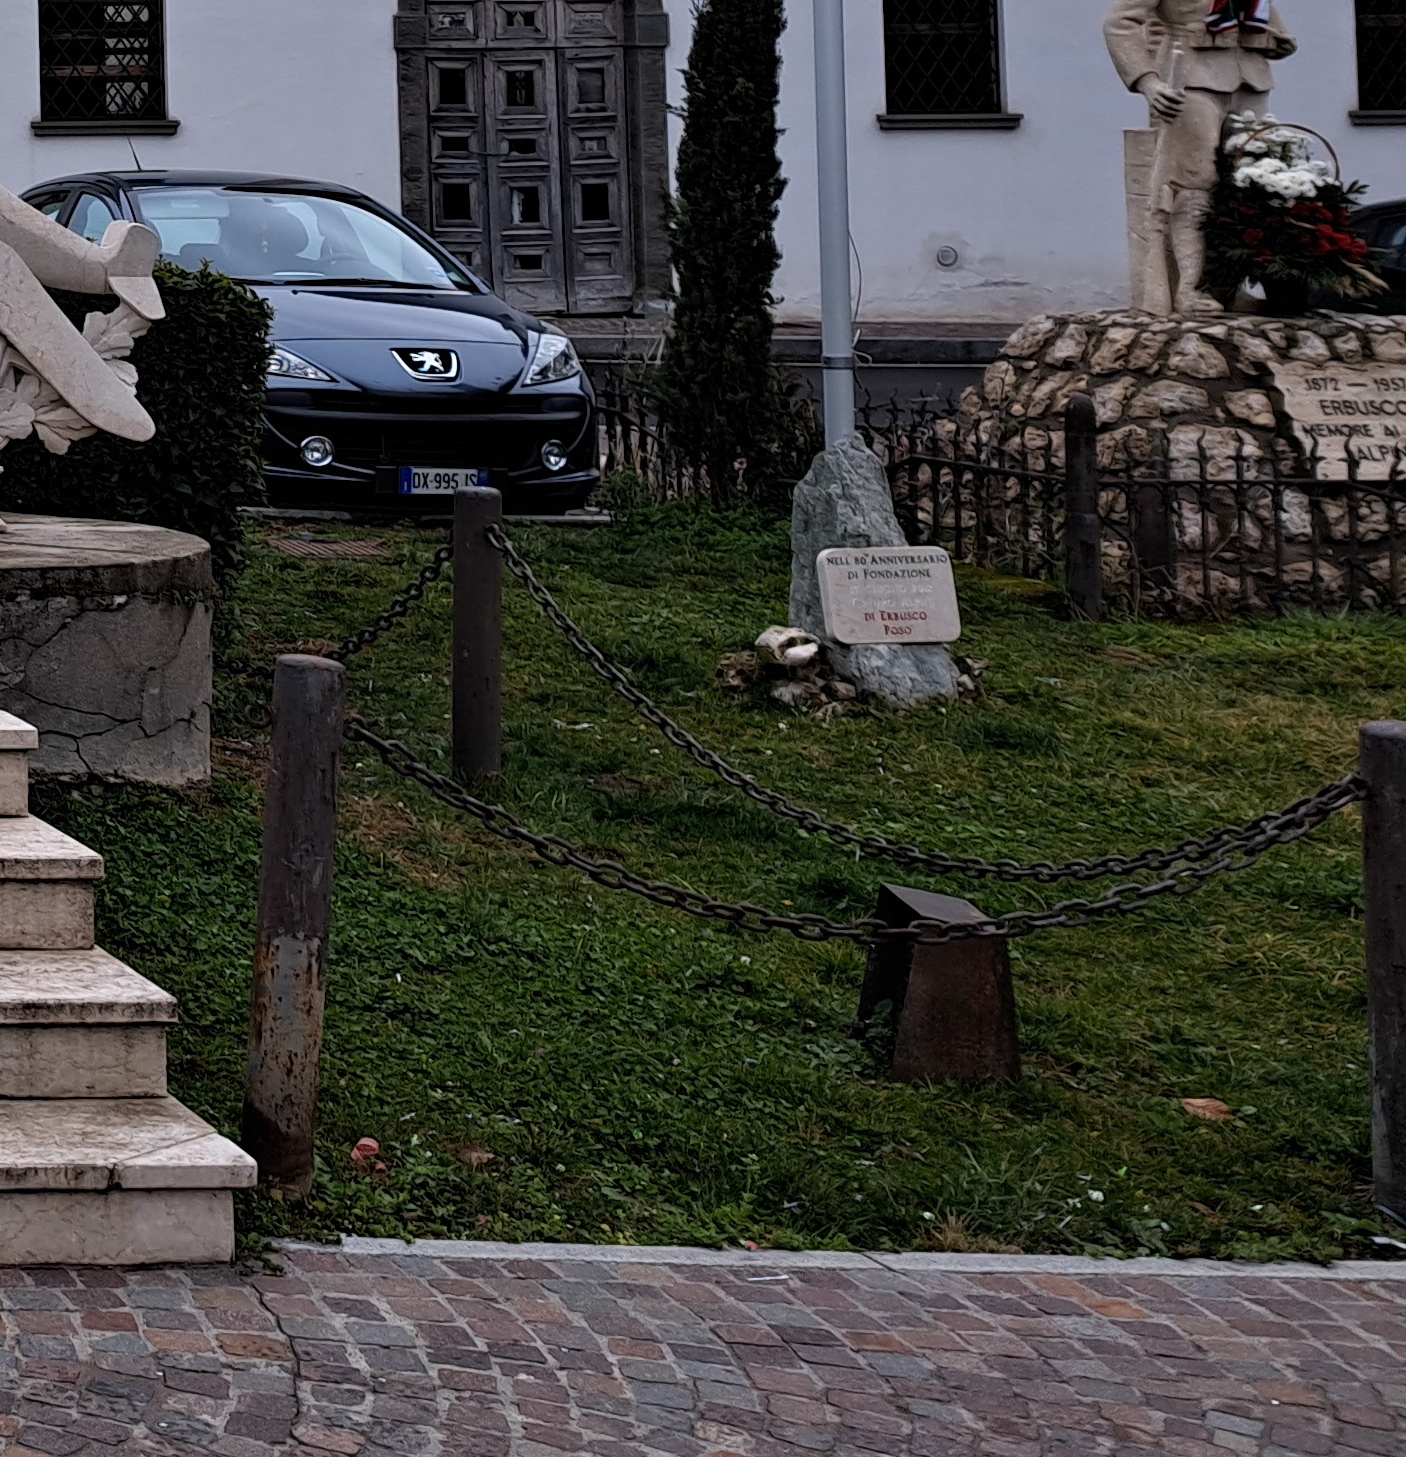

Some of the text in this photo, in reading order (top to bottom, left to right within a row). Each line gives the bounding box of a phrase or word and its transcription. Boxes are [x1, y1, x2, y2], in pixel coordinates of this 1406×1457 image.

[871, 555, 947, 565] ANNIVERSARIO
[848, 569, 931, 580] DI FONDAZIONE
[864, 610, 927, 622] DI ERBUSCO
